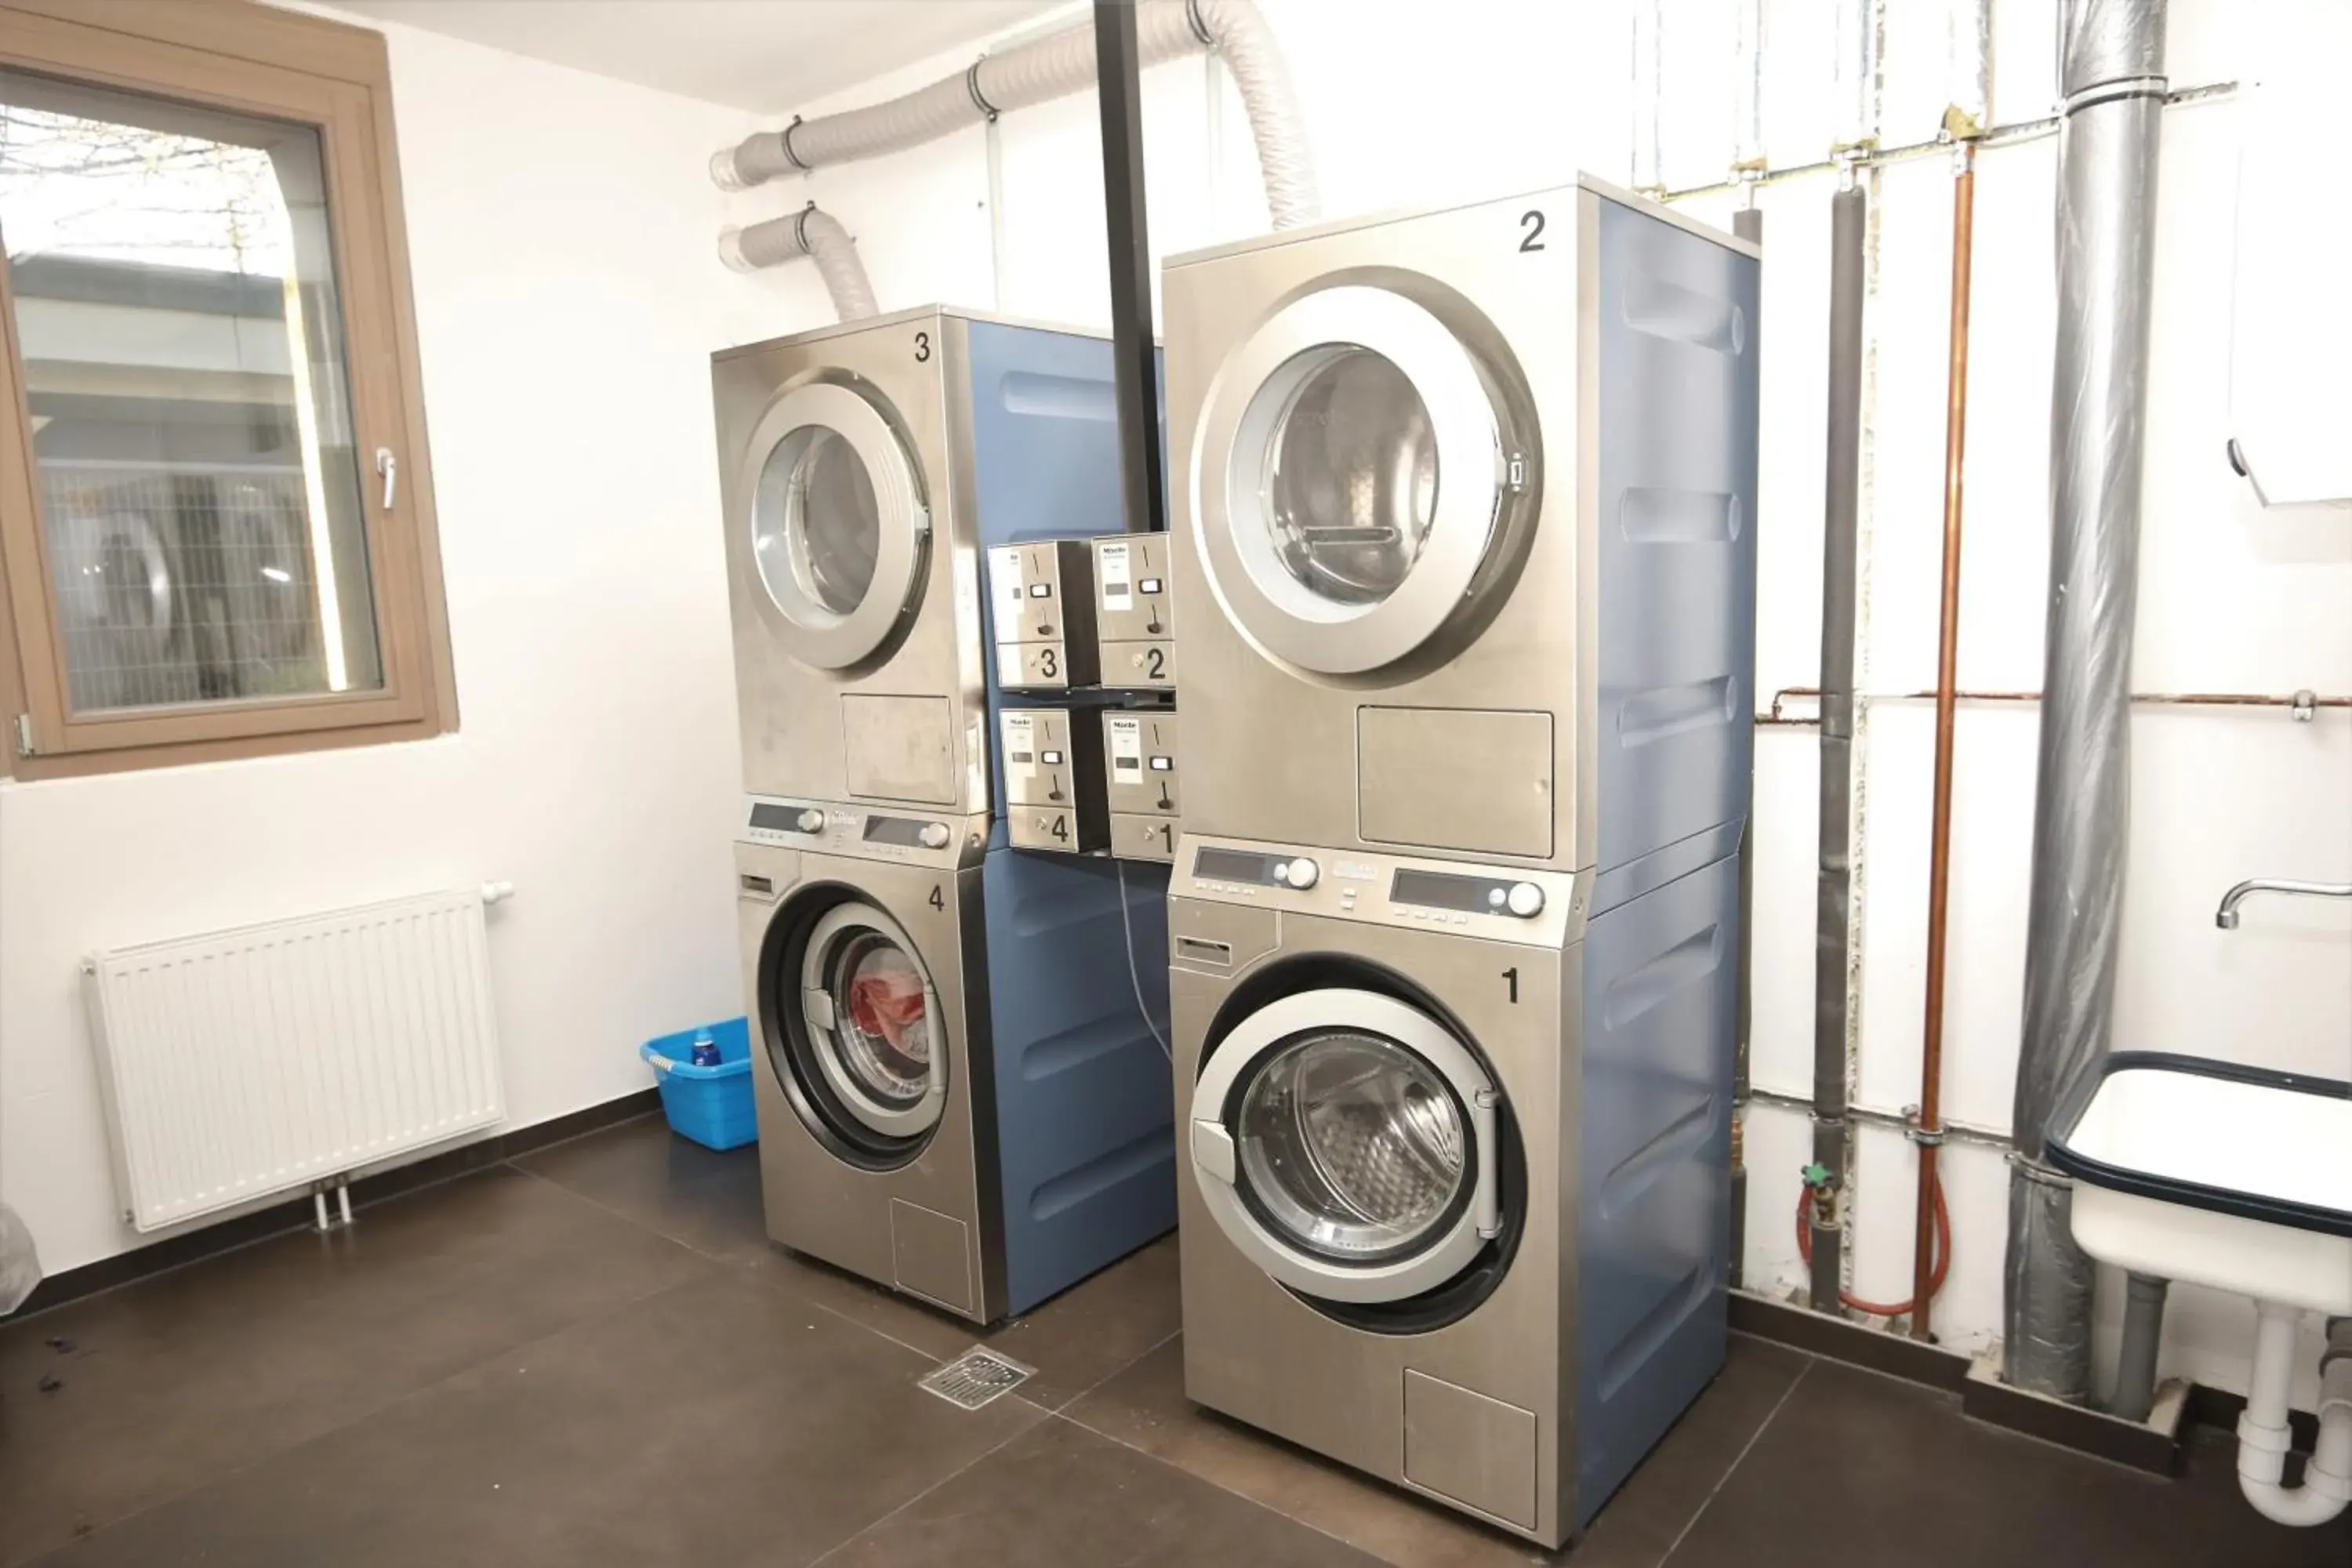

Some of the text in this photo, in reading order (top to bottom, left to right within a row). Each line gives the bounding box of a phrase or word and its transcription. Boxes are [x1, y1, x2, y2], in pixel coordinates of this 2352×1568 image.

[1519, 210, 1545, 253] 2
[915, 332, 931, 363] 3
[1040, 648, 1058, 678] 3
[1147, 648, 1166, 680] 2
[1051, 815, 1069, 843] 4
[1160, 823, 1172, 854] 1
[928, 884, 945, 912] 4
[1501, 967, 1518, 1004] 1
